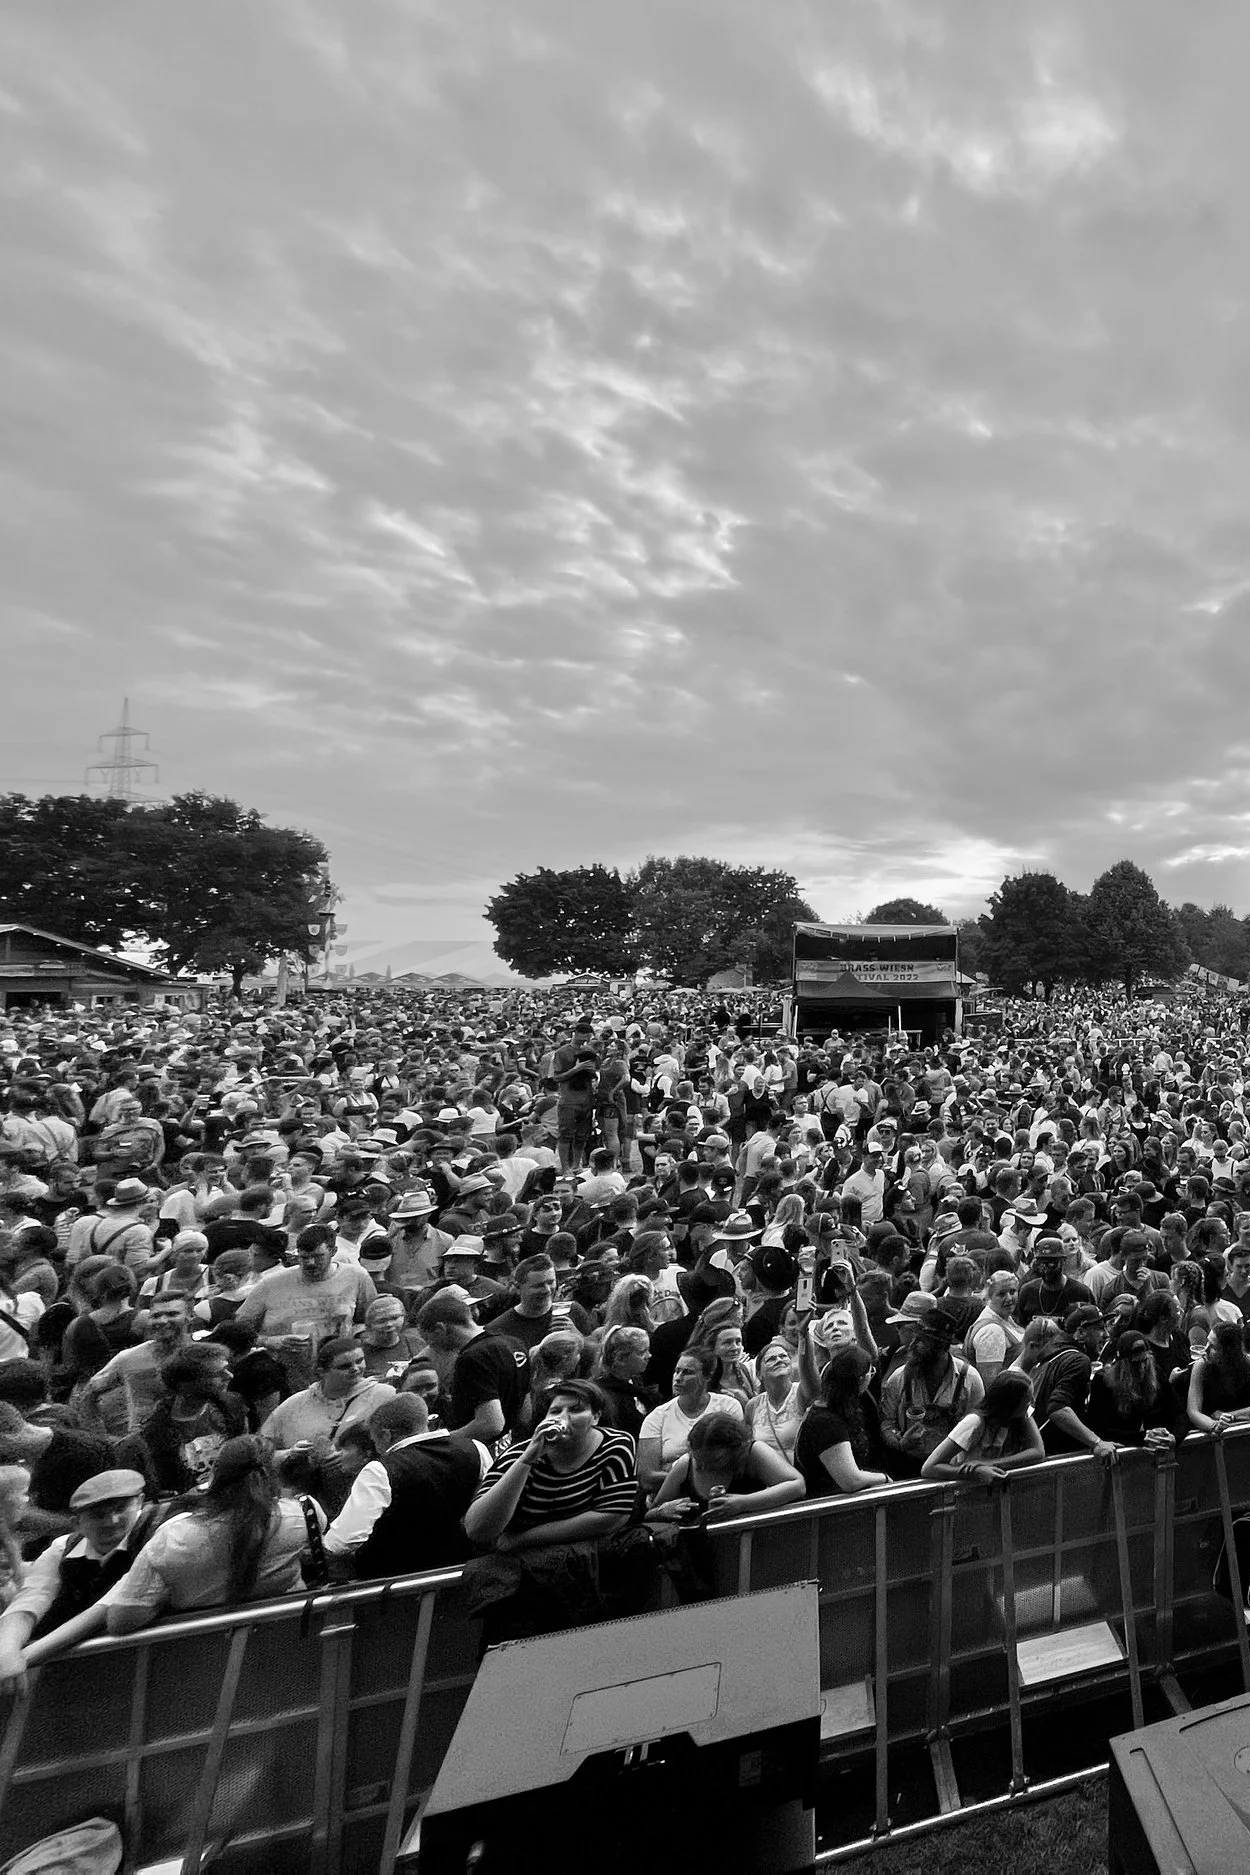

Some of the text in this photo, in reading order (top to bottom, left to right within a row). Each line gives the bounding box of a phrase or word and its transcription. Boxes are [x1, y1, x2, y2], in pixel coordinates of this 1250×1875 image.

[840, 964, 914, 972] BRASS WIESN
[893, 973, 920, 981] 2022
